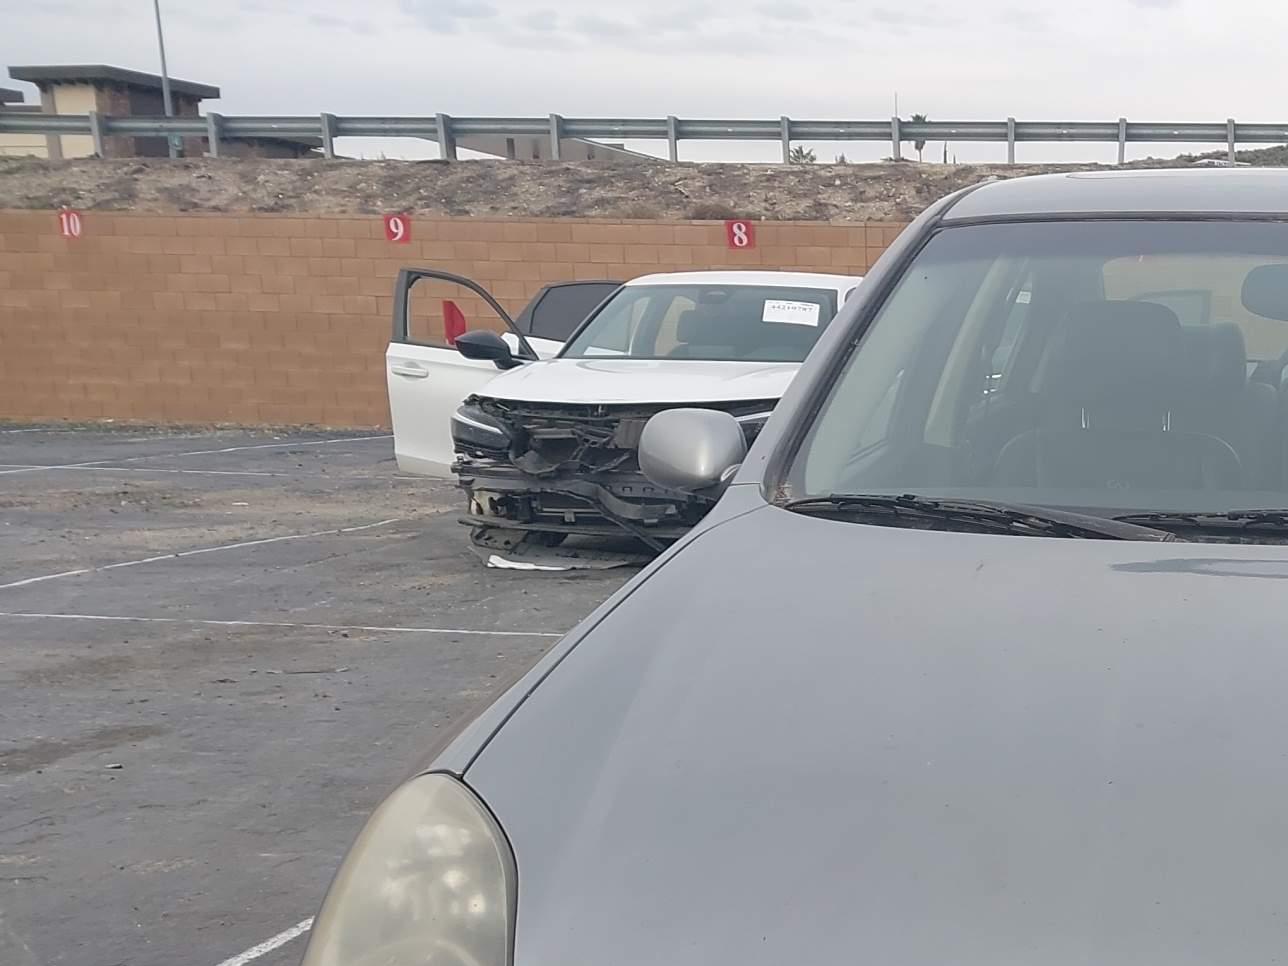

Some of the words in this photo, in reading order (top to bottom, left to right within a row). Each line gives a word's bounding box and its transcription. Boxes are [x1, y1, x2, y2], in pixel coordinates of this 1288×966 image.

[60, 212, 81, 237] 10
[389, 217, 404, 241] 9
[732, 222, 748, 247] 8
